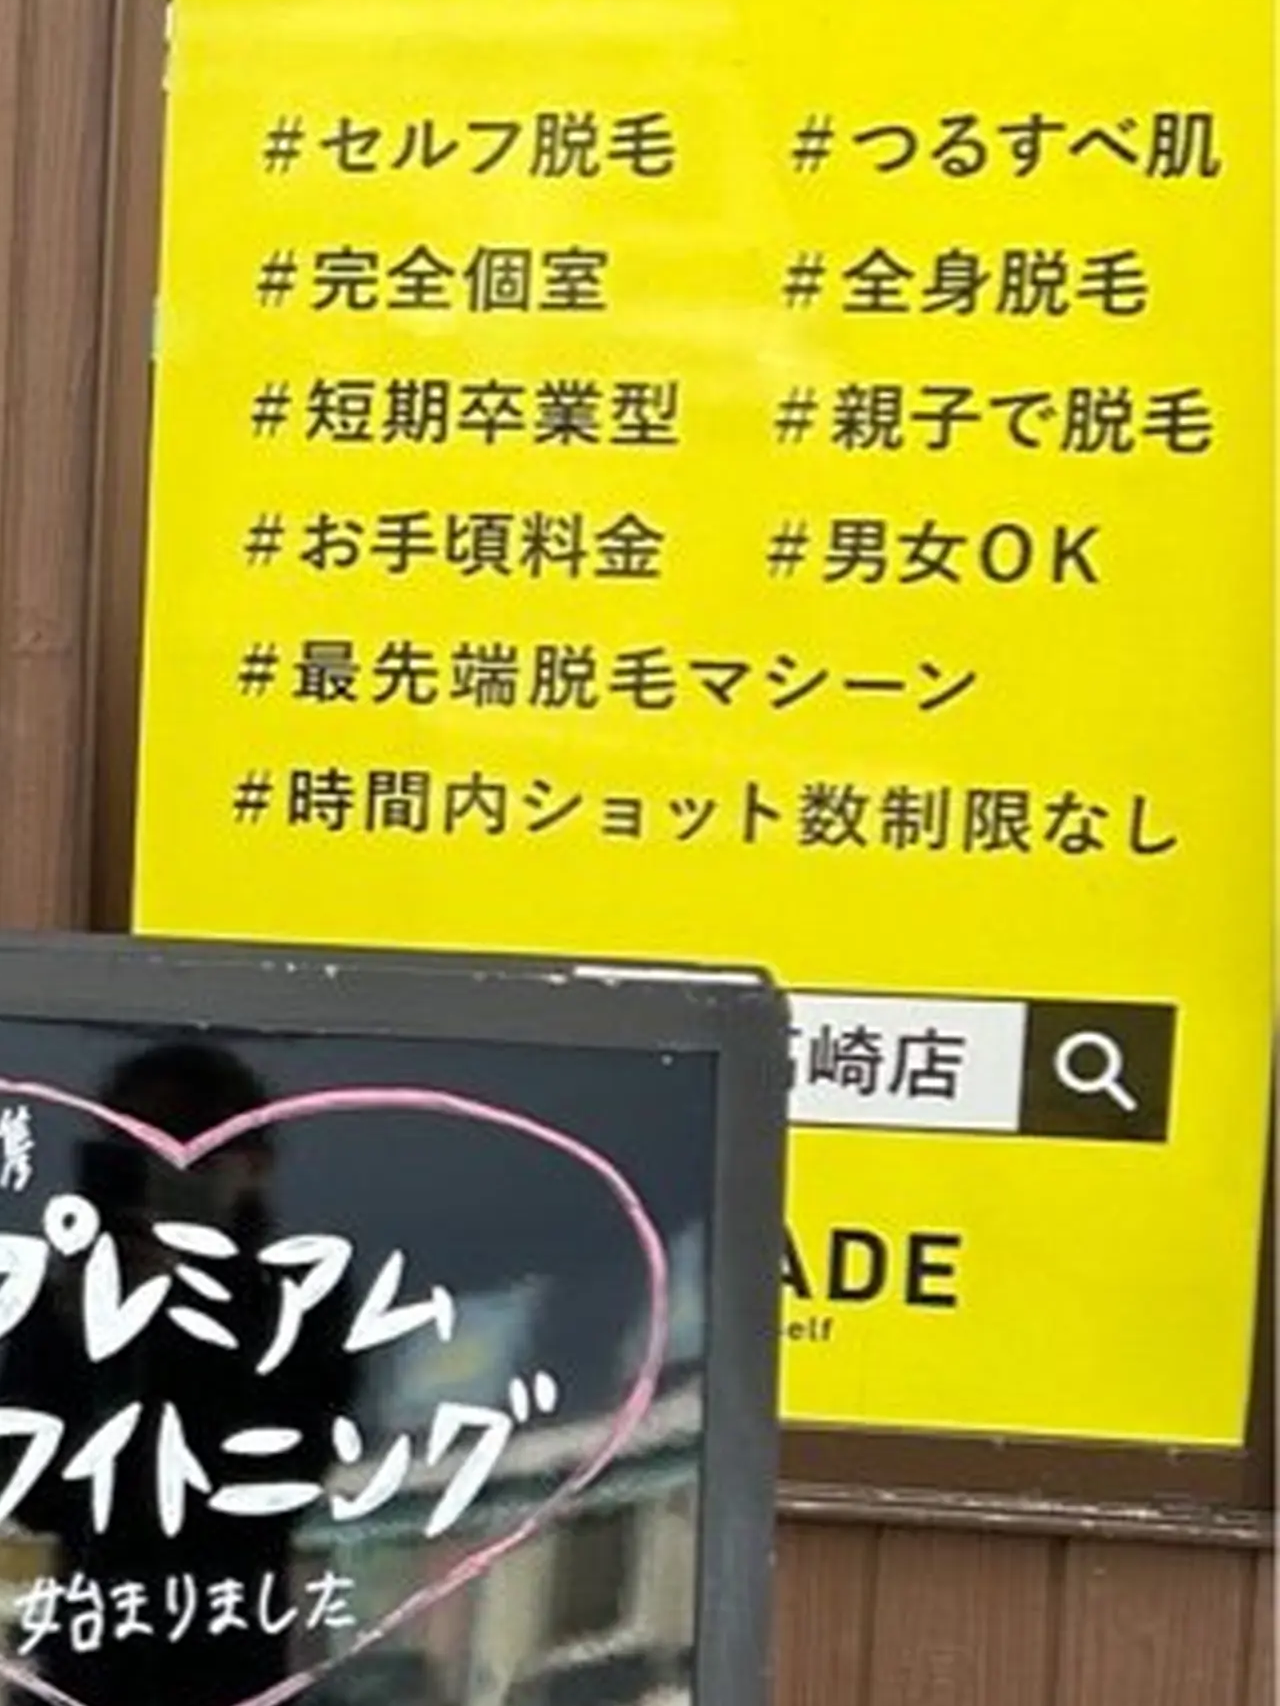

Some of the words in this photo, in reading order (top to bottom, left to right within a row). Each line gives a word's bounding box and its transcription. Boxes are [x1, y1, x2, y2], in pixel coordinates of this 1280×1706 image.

[264, 111, 677, 179] #セルフ脱毛
[790, 112, 1222, 182] #つるすべ肌
[255, 246, 608, 315] #完全個室
[783, 247, 1149, 319] #全身脱毛
[251, 377, 681, 448] #短期卒業型
[773, 383, 1214, 454] #親子で脱毛
[243, 509, 665, 580] #お手頃料金
[765, 519, 1101, 586] #男女OK
[237, 641, 977, 713] #最先端脱毛マシーン
[231, 768, 1179, 855] #時間内ショット数制限なし
[785, 1023, 966, 1100] 崎店
[14, 1571, 358, 1656] 始まりました
